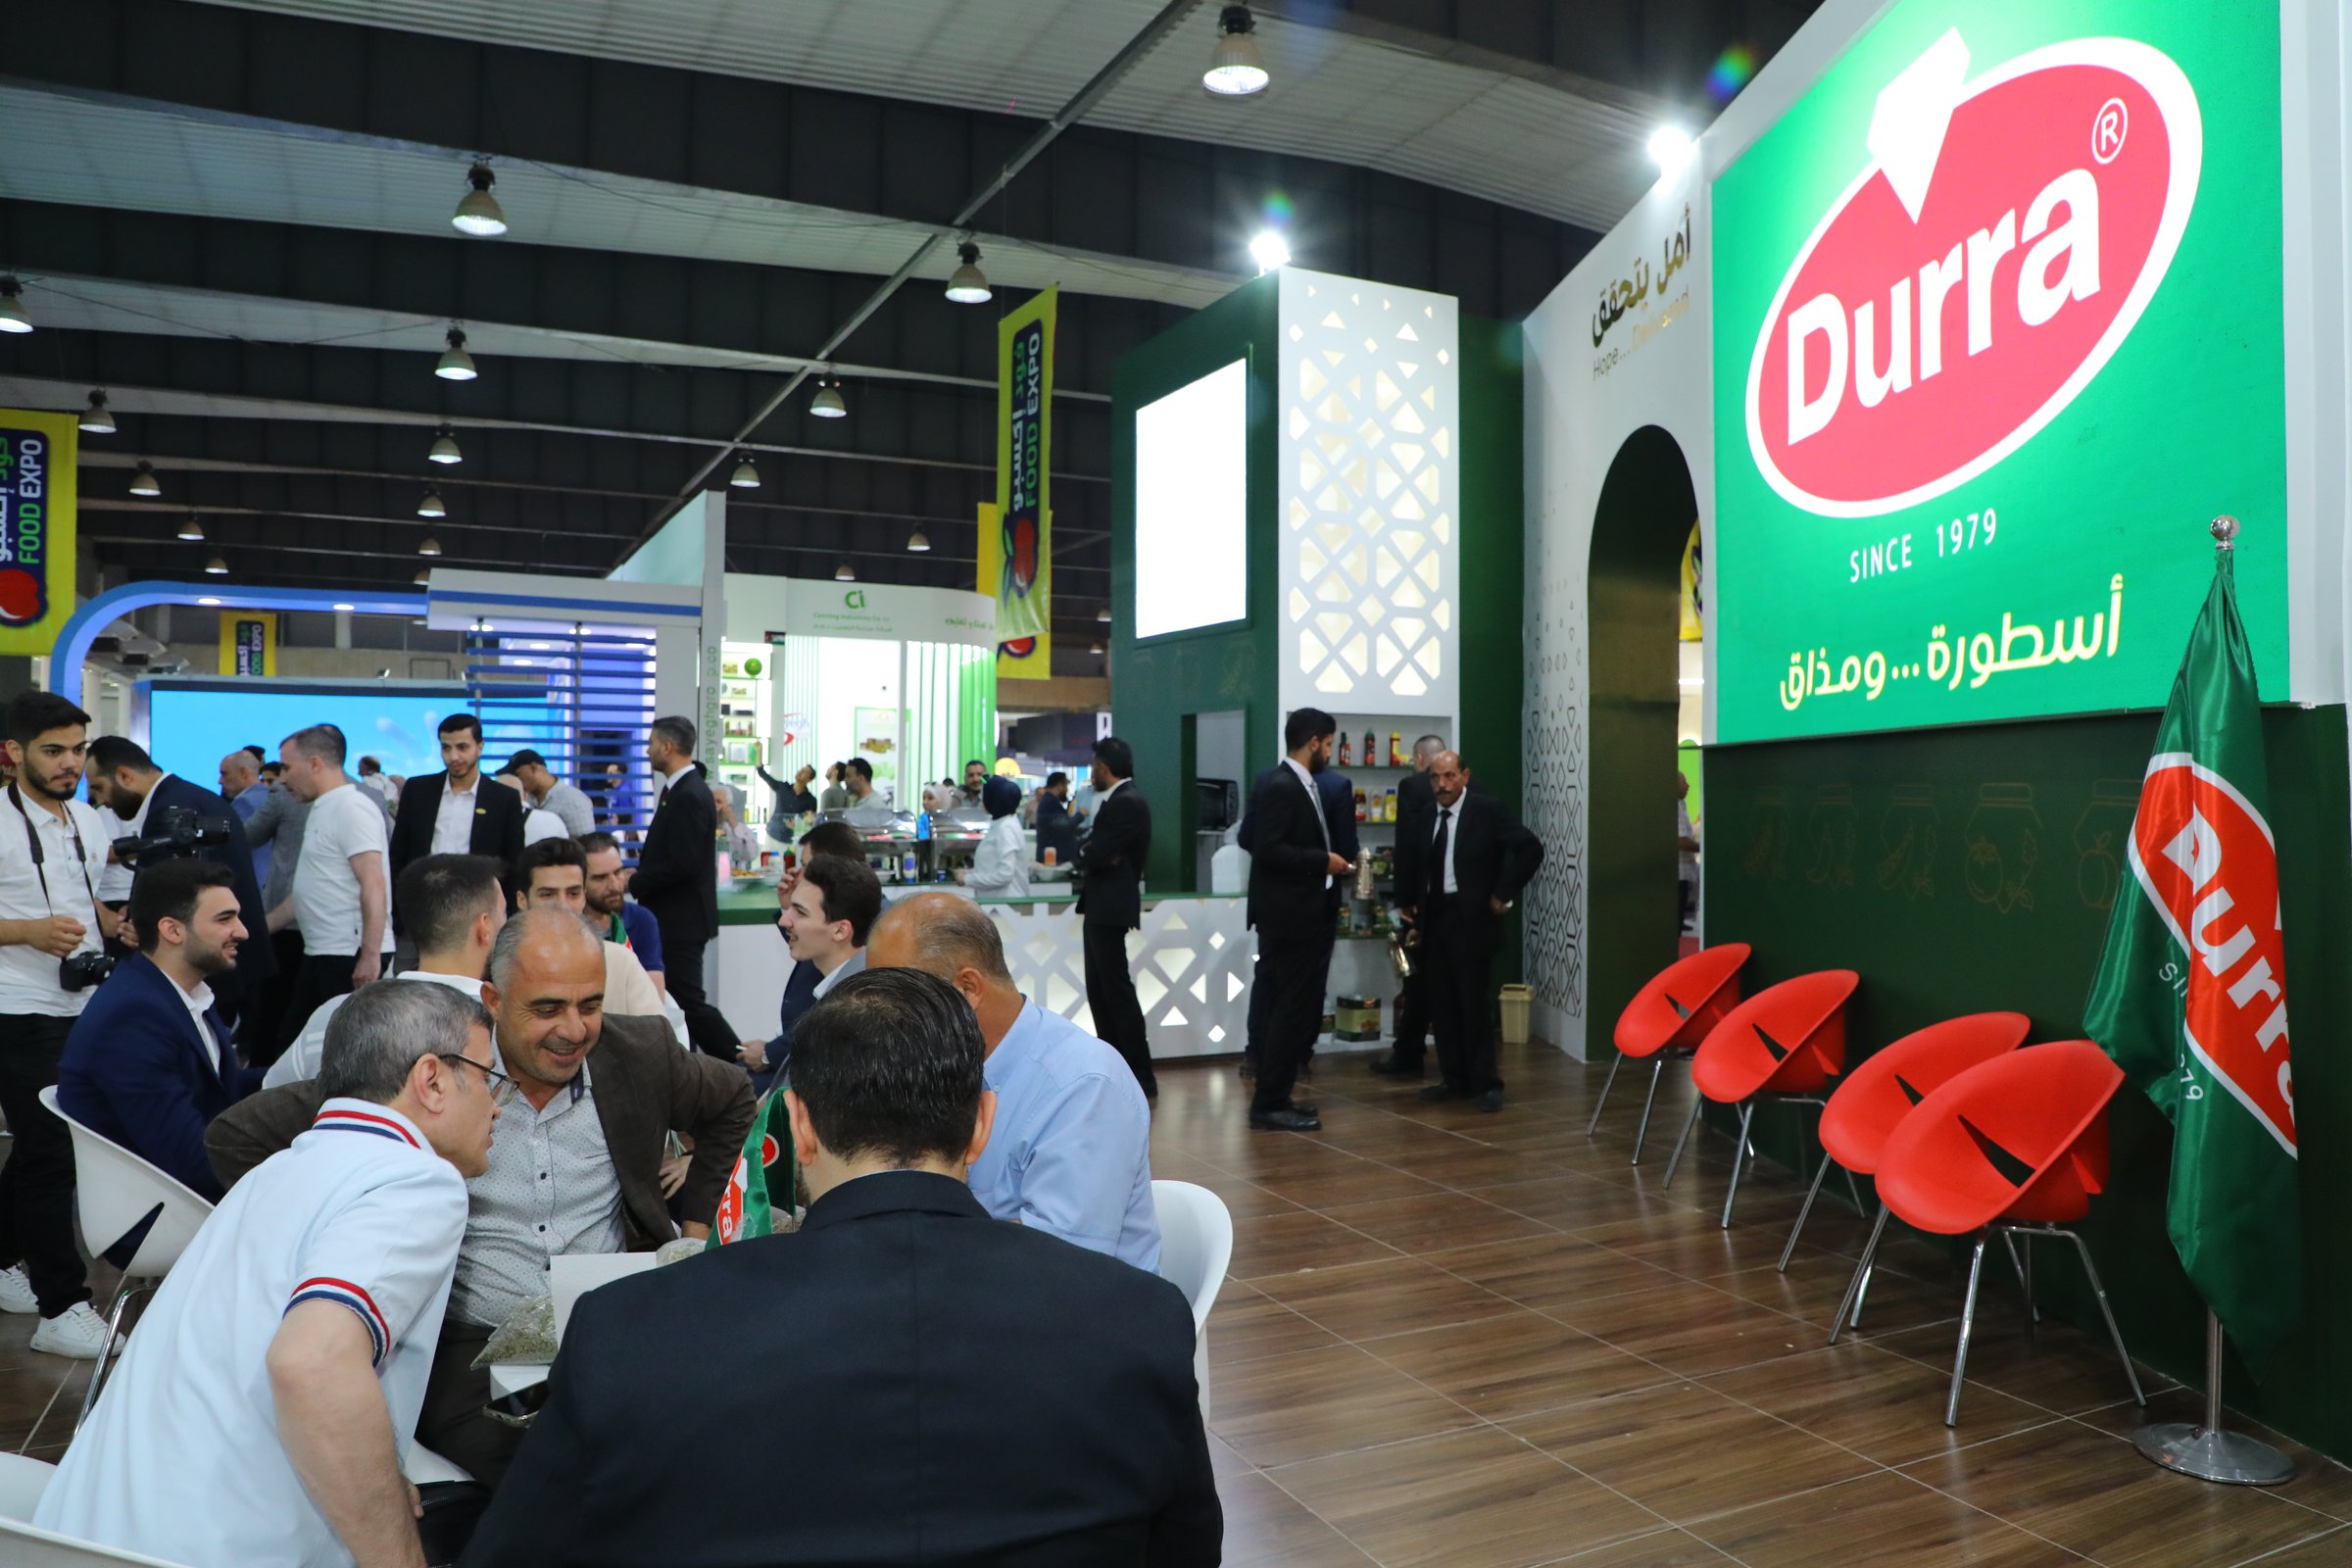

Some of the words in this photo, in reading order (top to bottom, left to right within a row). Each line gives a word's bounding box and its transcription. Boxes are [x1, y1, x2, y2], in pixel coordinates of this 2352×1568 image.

[1656, 202, 1691, 296] أمل
[1592, 257, 1649, 349] يتحقق
[1788, 169, 2101, 447] Durra
[1026, 332, 1041, 416] EXPO
[19, 438, 43, 499] EXPO
[1026, 422, 1039, 507] FOOD
[18, 502, 42, 564] FOOD
[1849, 532, 1913, 583] SINCE
[1936, 508, 1997, 560] 1979
[1779, 646, 1886, 710] ومذاق
